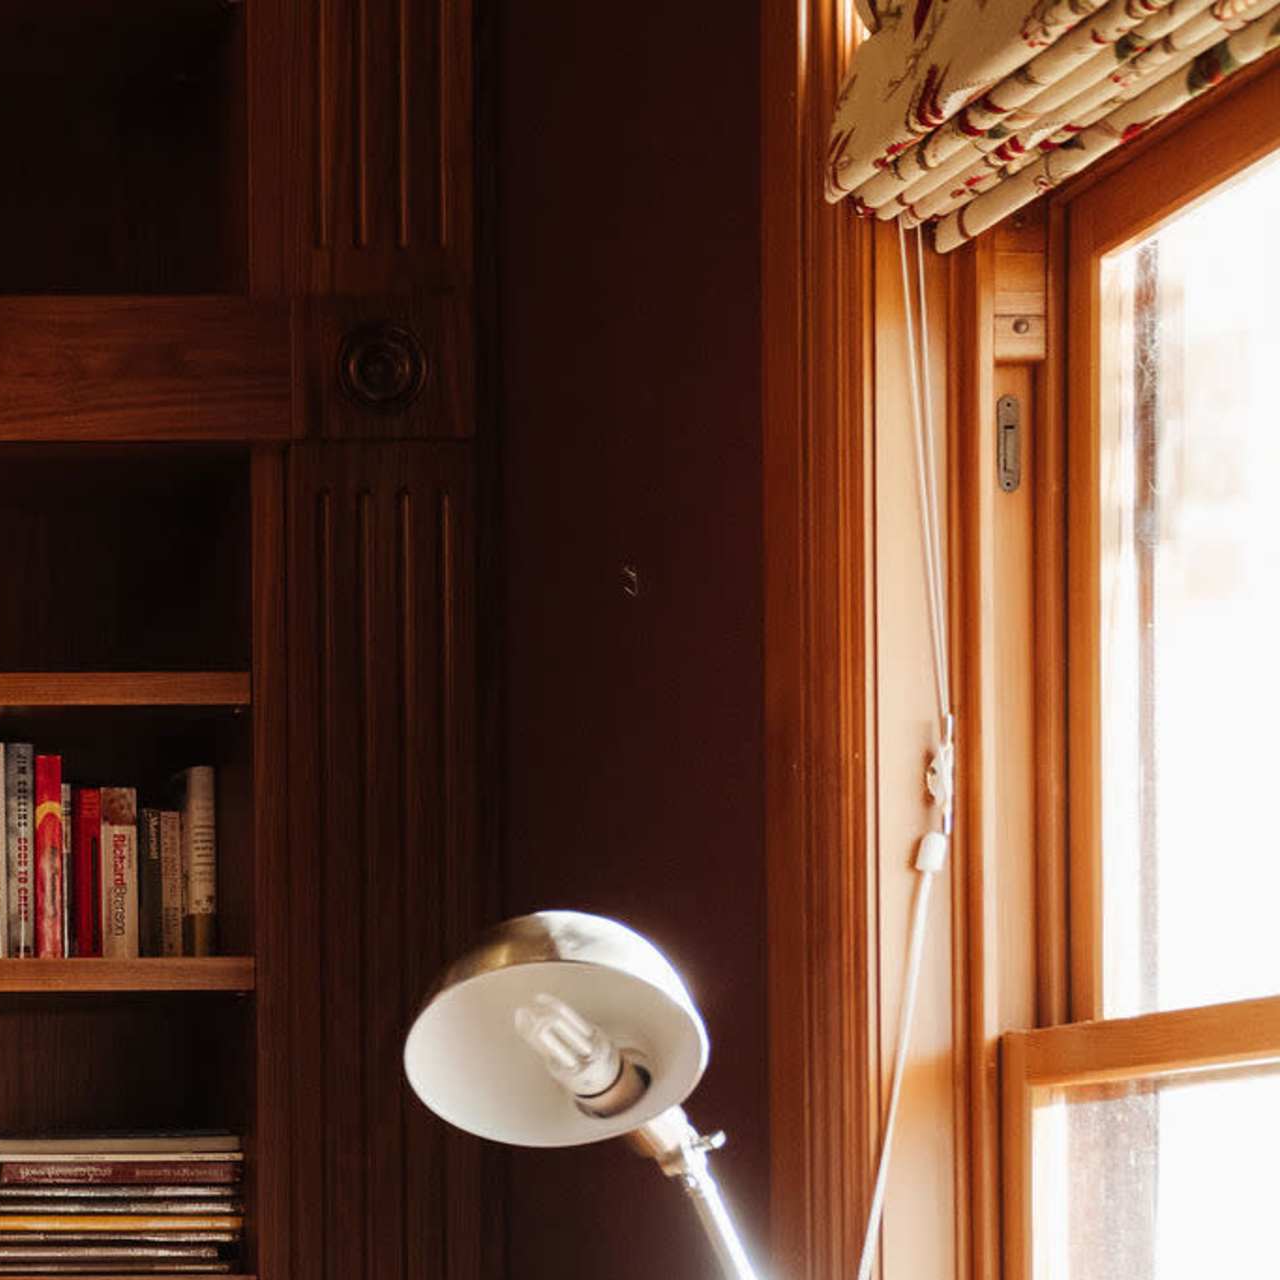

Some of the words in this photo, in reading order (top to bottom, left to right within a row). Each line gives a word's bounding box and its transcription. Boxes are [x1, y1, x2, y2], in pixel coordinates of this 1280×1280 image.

[17, 754, 29, 776] JIM
[17, 780, 29, 829] COLLINS
[17, 837, 30, 868] GOOD
[17, 871, 30, 884] TO
[17, 887, 30, 923] GREAT
